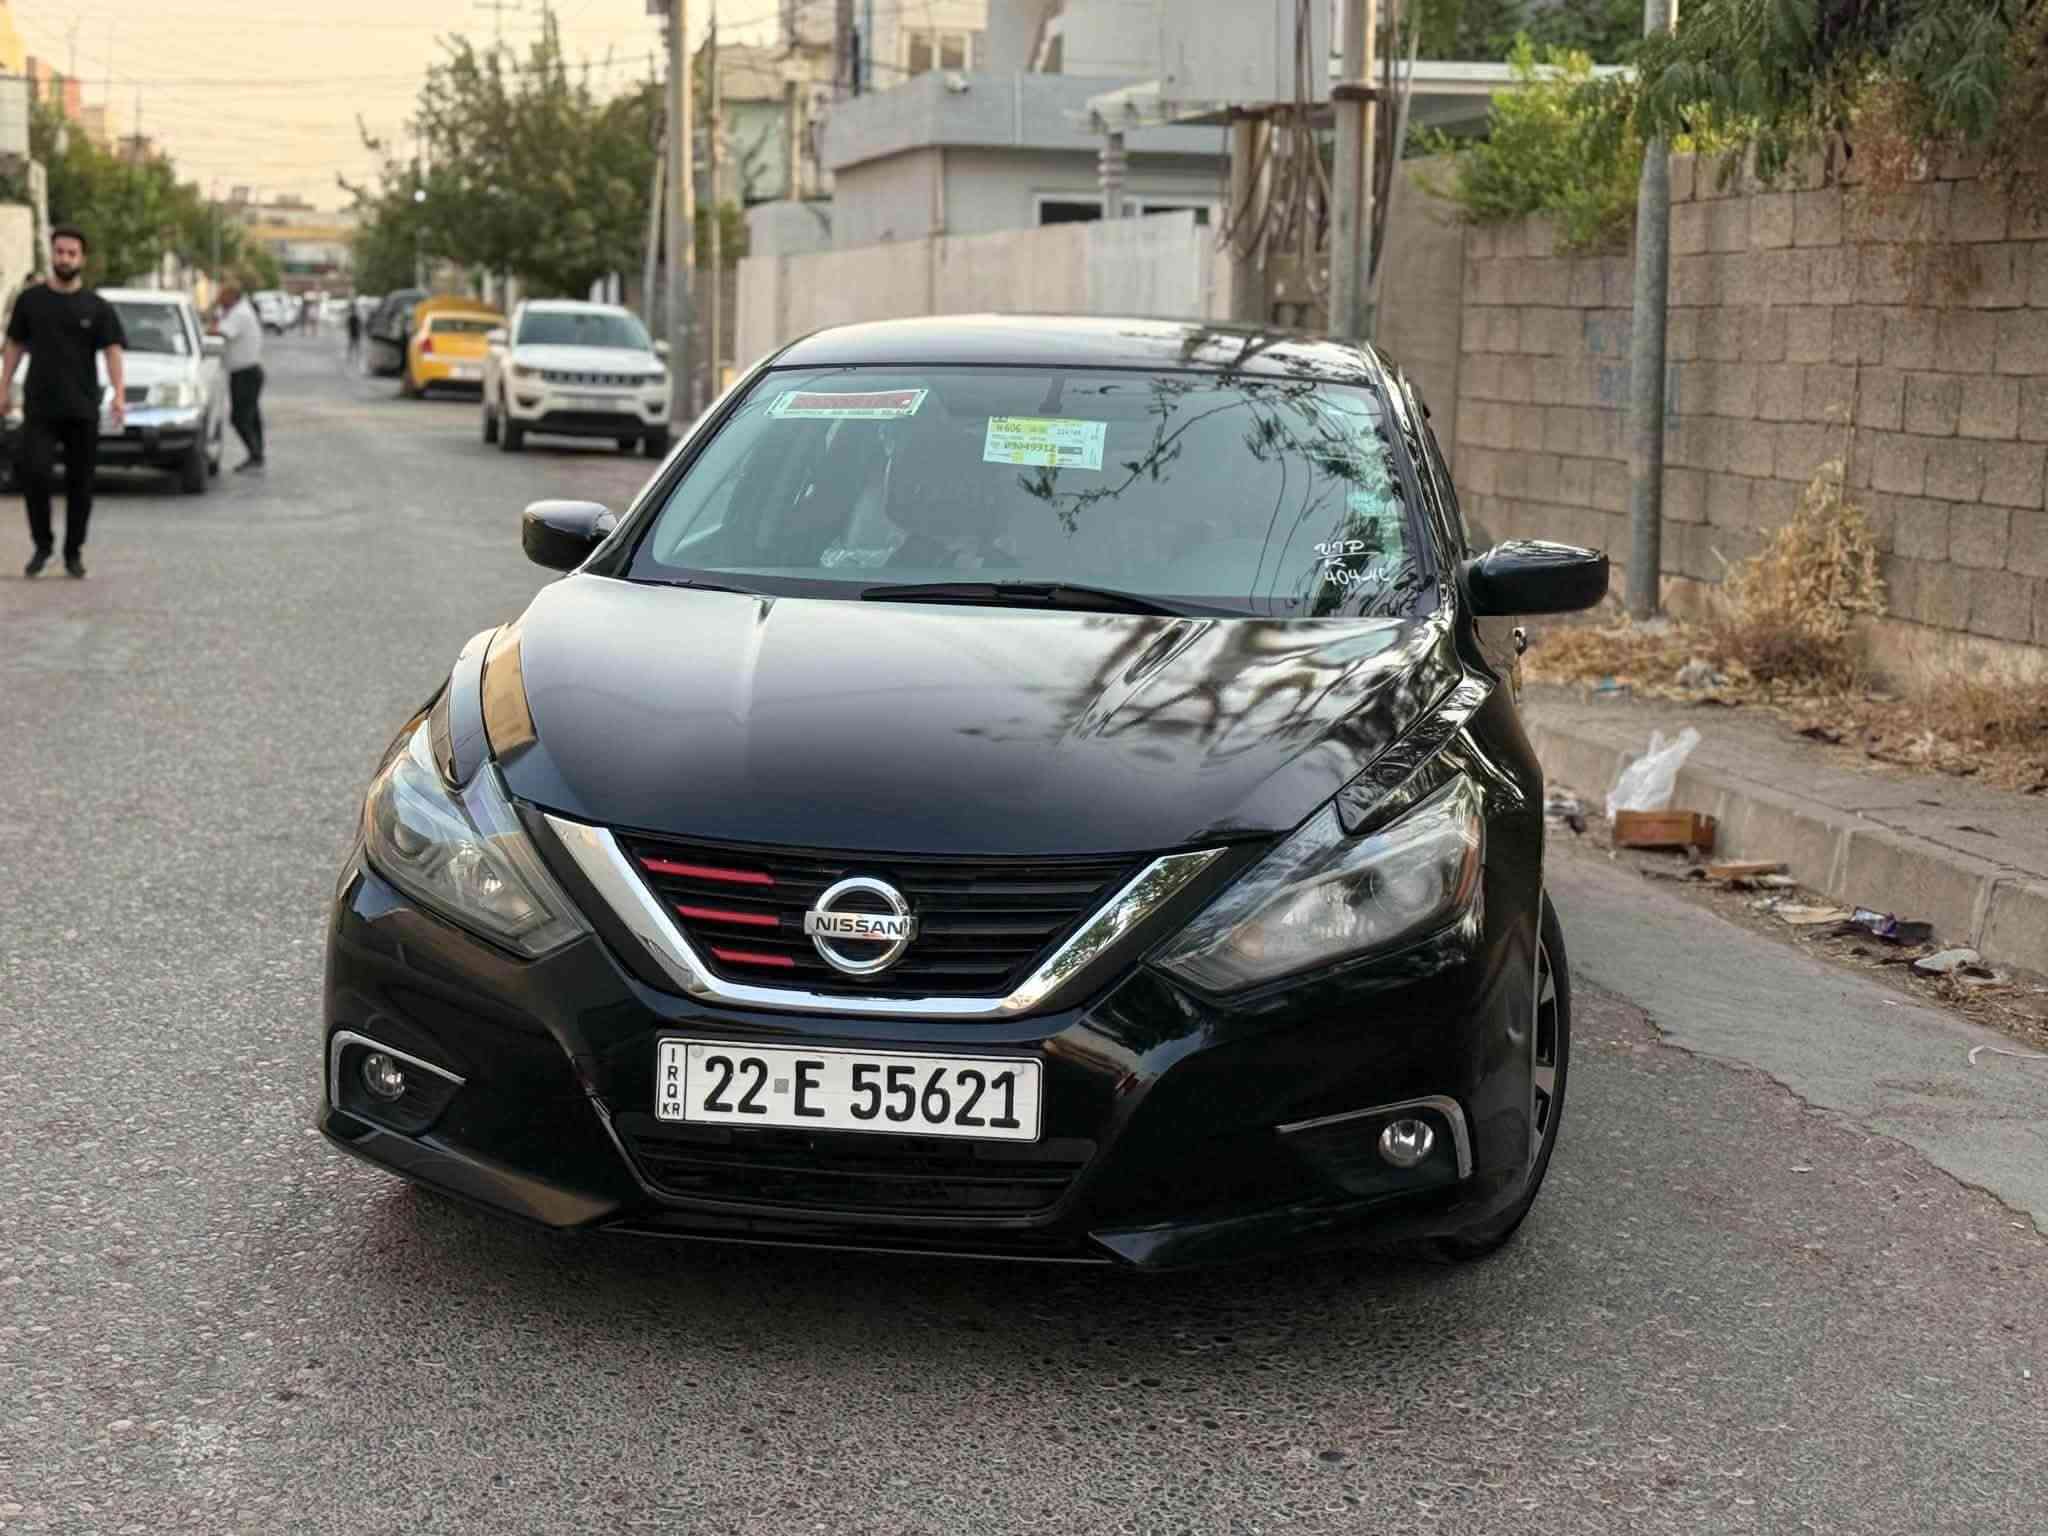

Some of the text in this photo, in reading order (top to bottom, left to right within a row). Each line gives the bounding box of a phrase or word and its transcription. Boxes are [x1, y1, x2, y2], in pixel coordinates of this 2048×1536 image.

[816, 917, 903, 935] NISSAN
[704, 1056, 1020, 1128] 22 E 55621
[662, 1102, 680, 1116] KR
